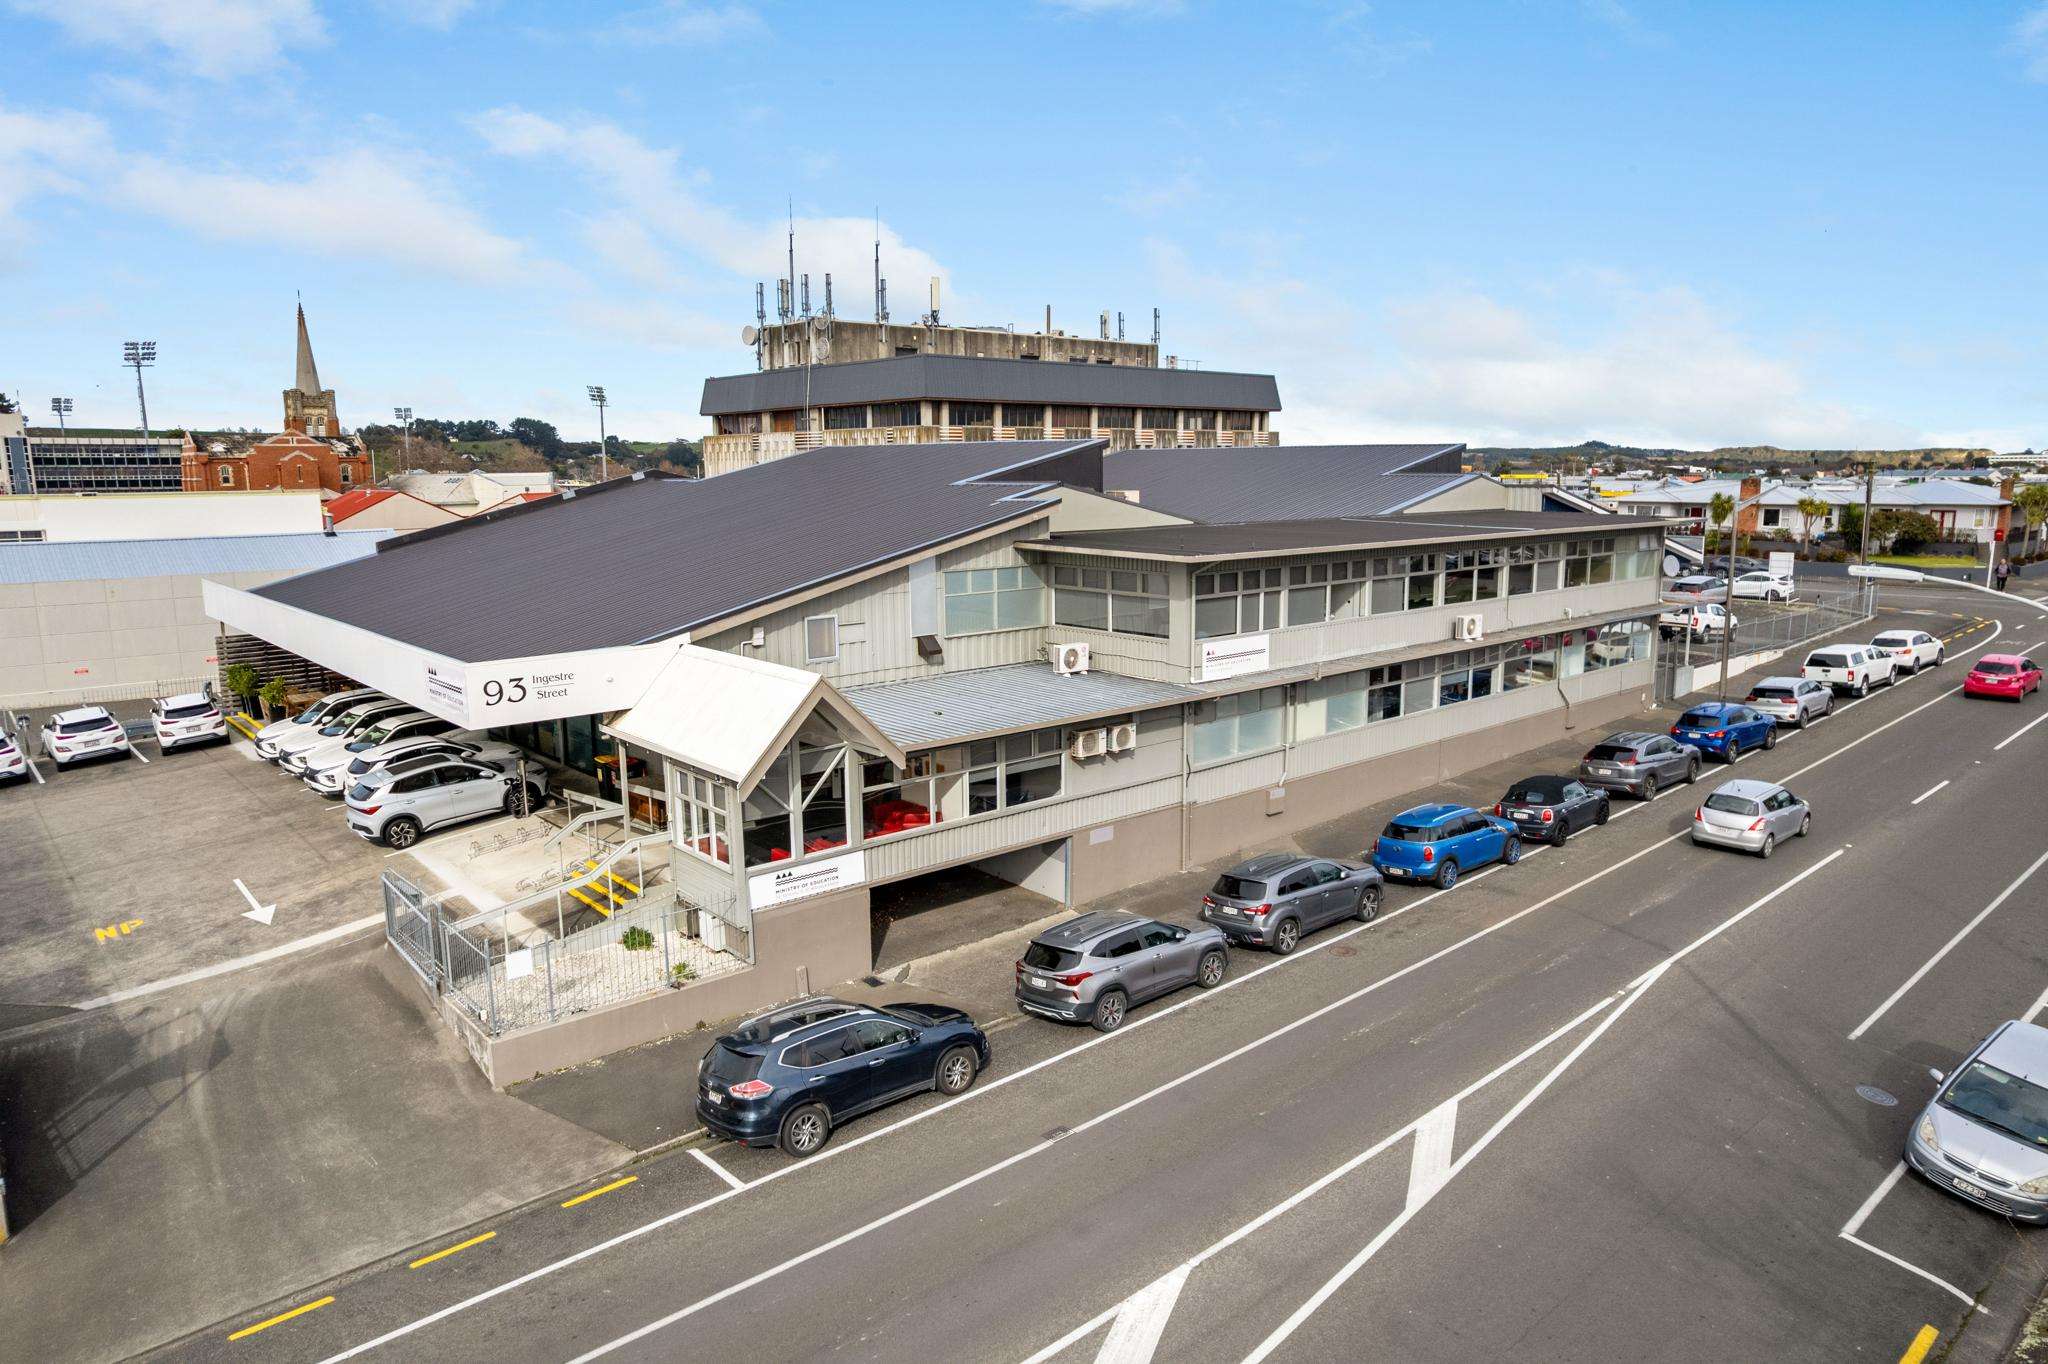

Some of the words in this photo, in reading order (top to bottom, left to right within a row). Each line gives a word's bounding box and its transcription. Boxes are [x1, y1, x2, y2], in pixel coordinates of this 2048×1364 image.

[532, 671, 575, 685] Ingestre
[483, 677, 527, 706] 93
[536, 688, 568, 700] Street
[776, 885, 800, 893] MINISTRY
[810, 875, 839, 886] EDUCATION
